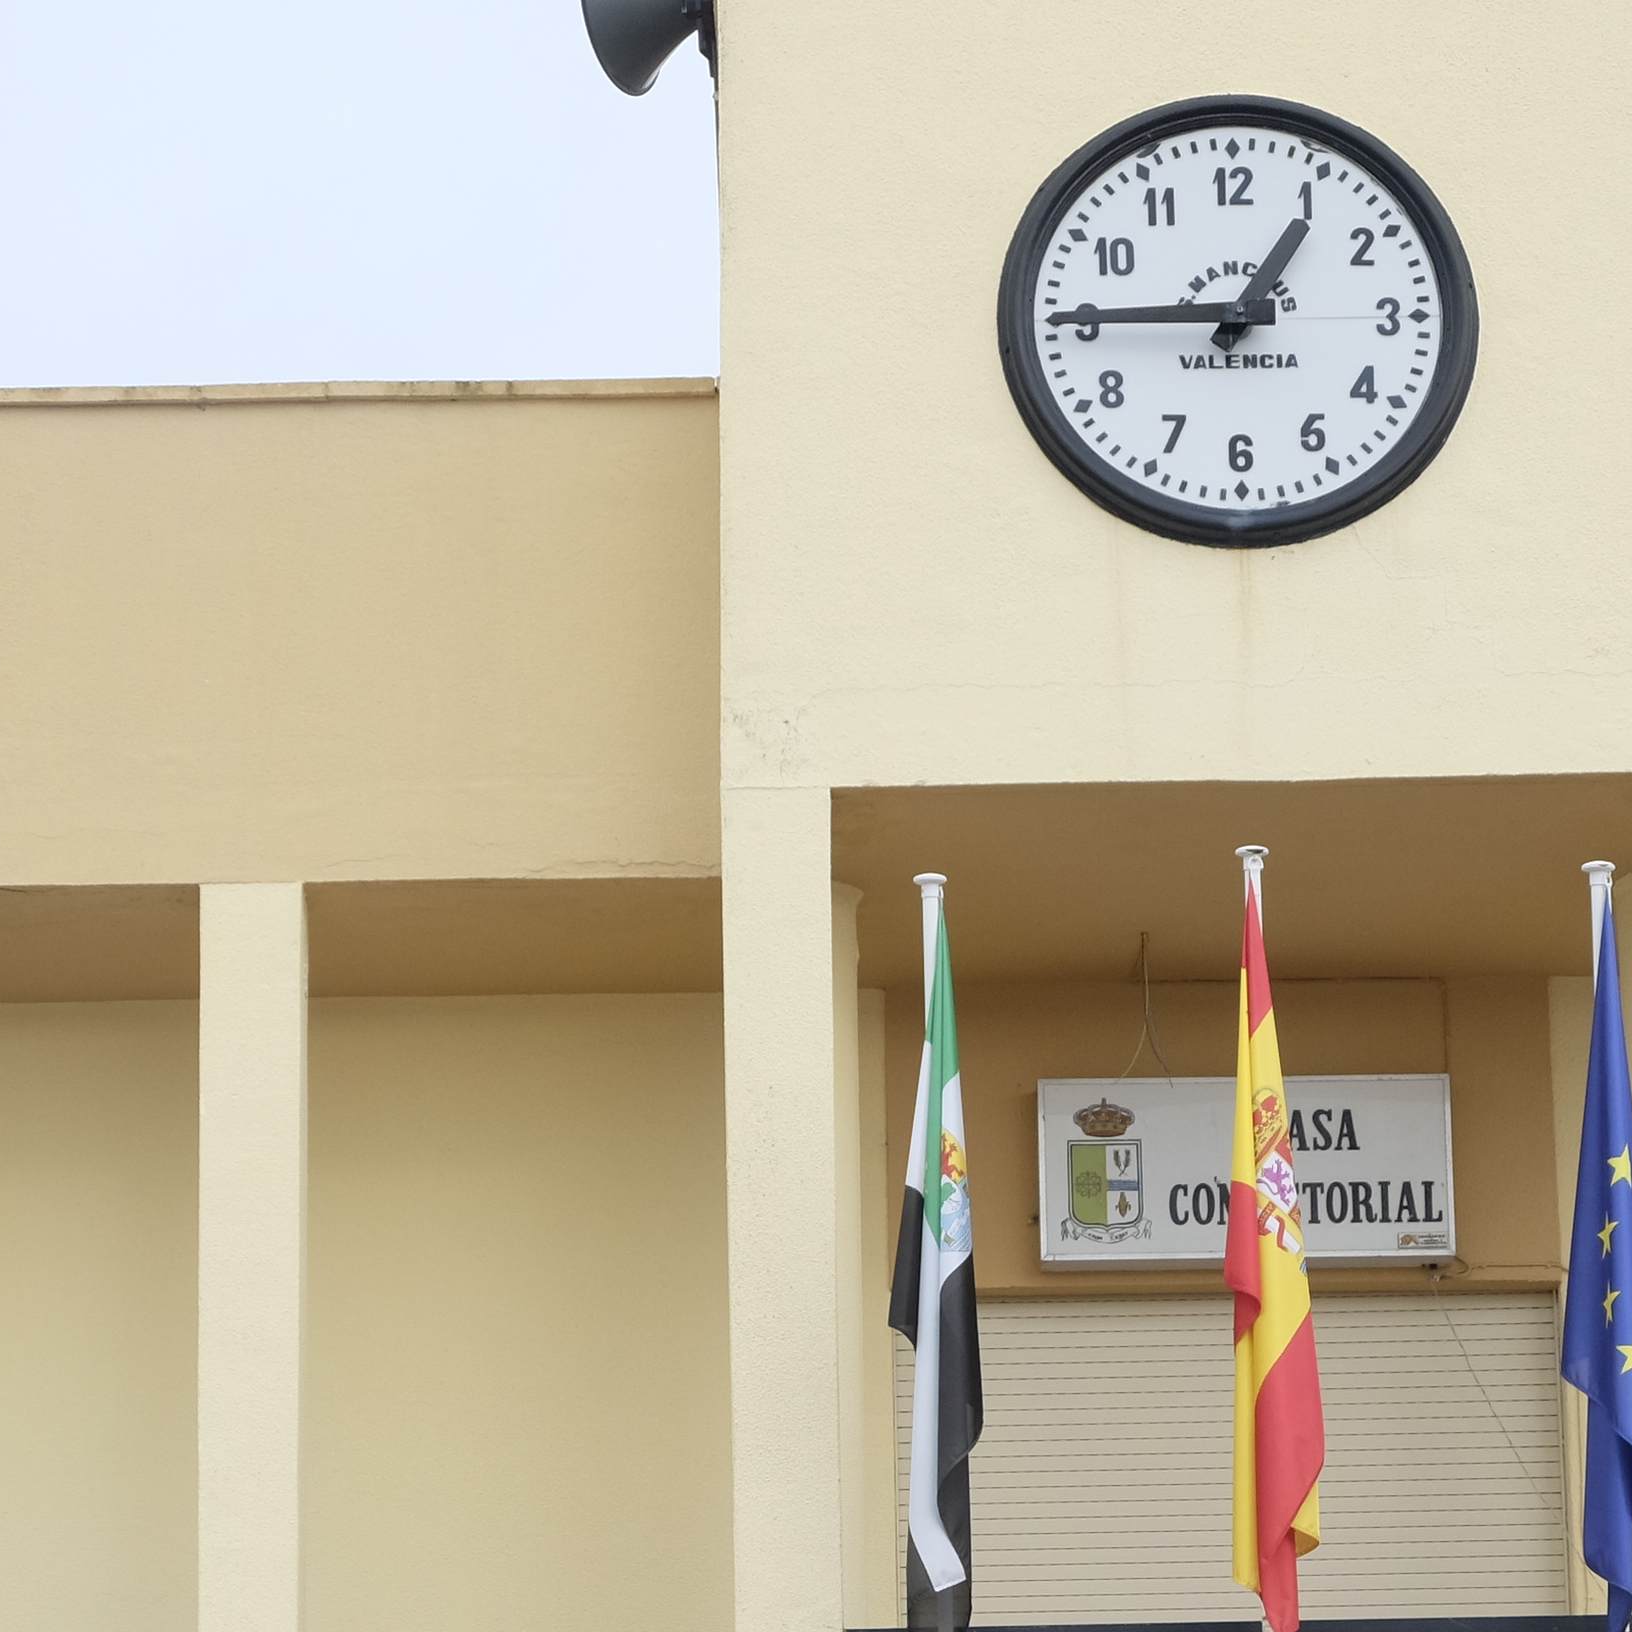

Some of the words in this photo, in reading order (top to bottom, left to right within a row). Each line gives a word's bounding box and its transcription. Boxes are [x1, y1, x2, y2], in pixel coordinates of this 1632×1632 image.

[1213, 166, 1254, 206] 12
[1297, 181, 1312, 220] 1
[1143, 187, 1176, 226] 11
[1093, 237, 1135, 276] 10
[1350, 227, 1375, 266] 2
[1075, 303, 1099, 342] 9
[1376, 297, 1401, 336] 3
[1179, 354, 1299, 370] VALENCIA
[1099, 370, 1125, 408] 8
[1350, 366, 1378, 404] 4
[1162, 414, 1187, 454] 7
[1300, 413, 1326, 452] 5
[1228, 434, 1254, 472] 6
[1289, 1109, 1361, 1151] ASA
[1169, 1181, 1443, 1225] CONTORIAL
